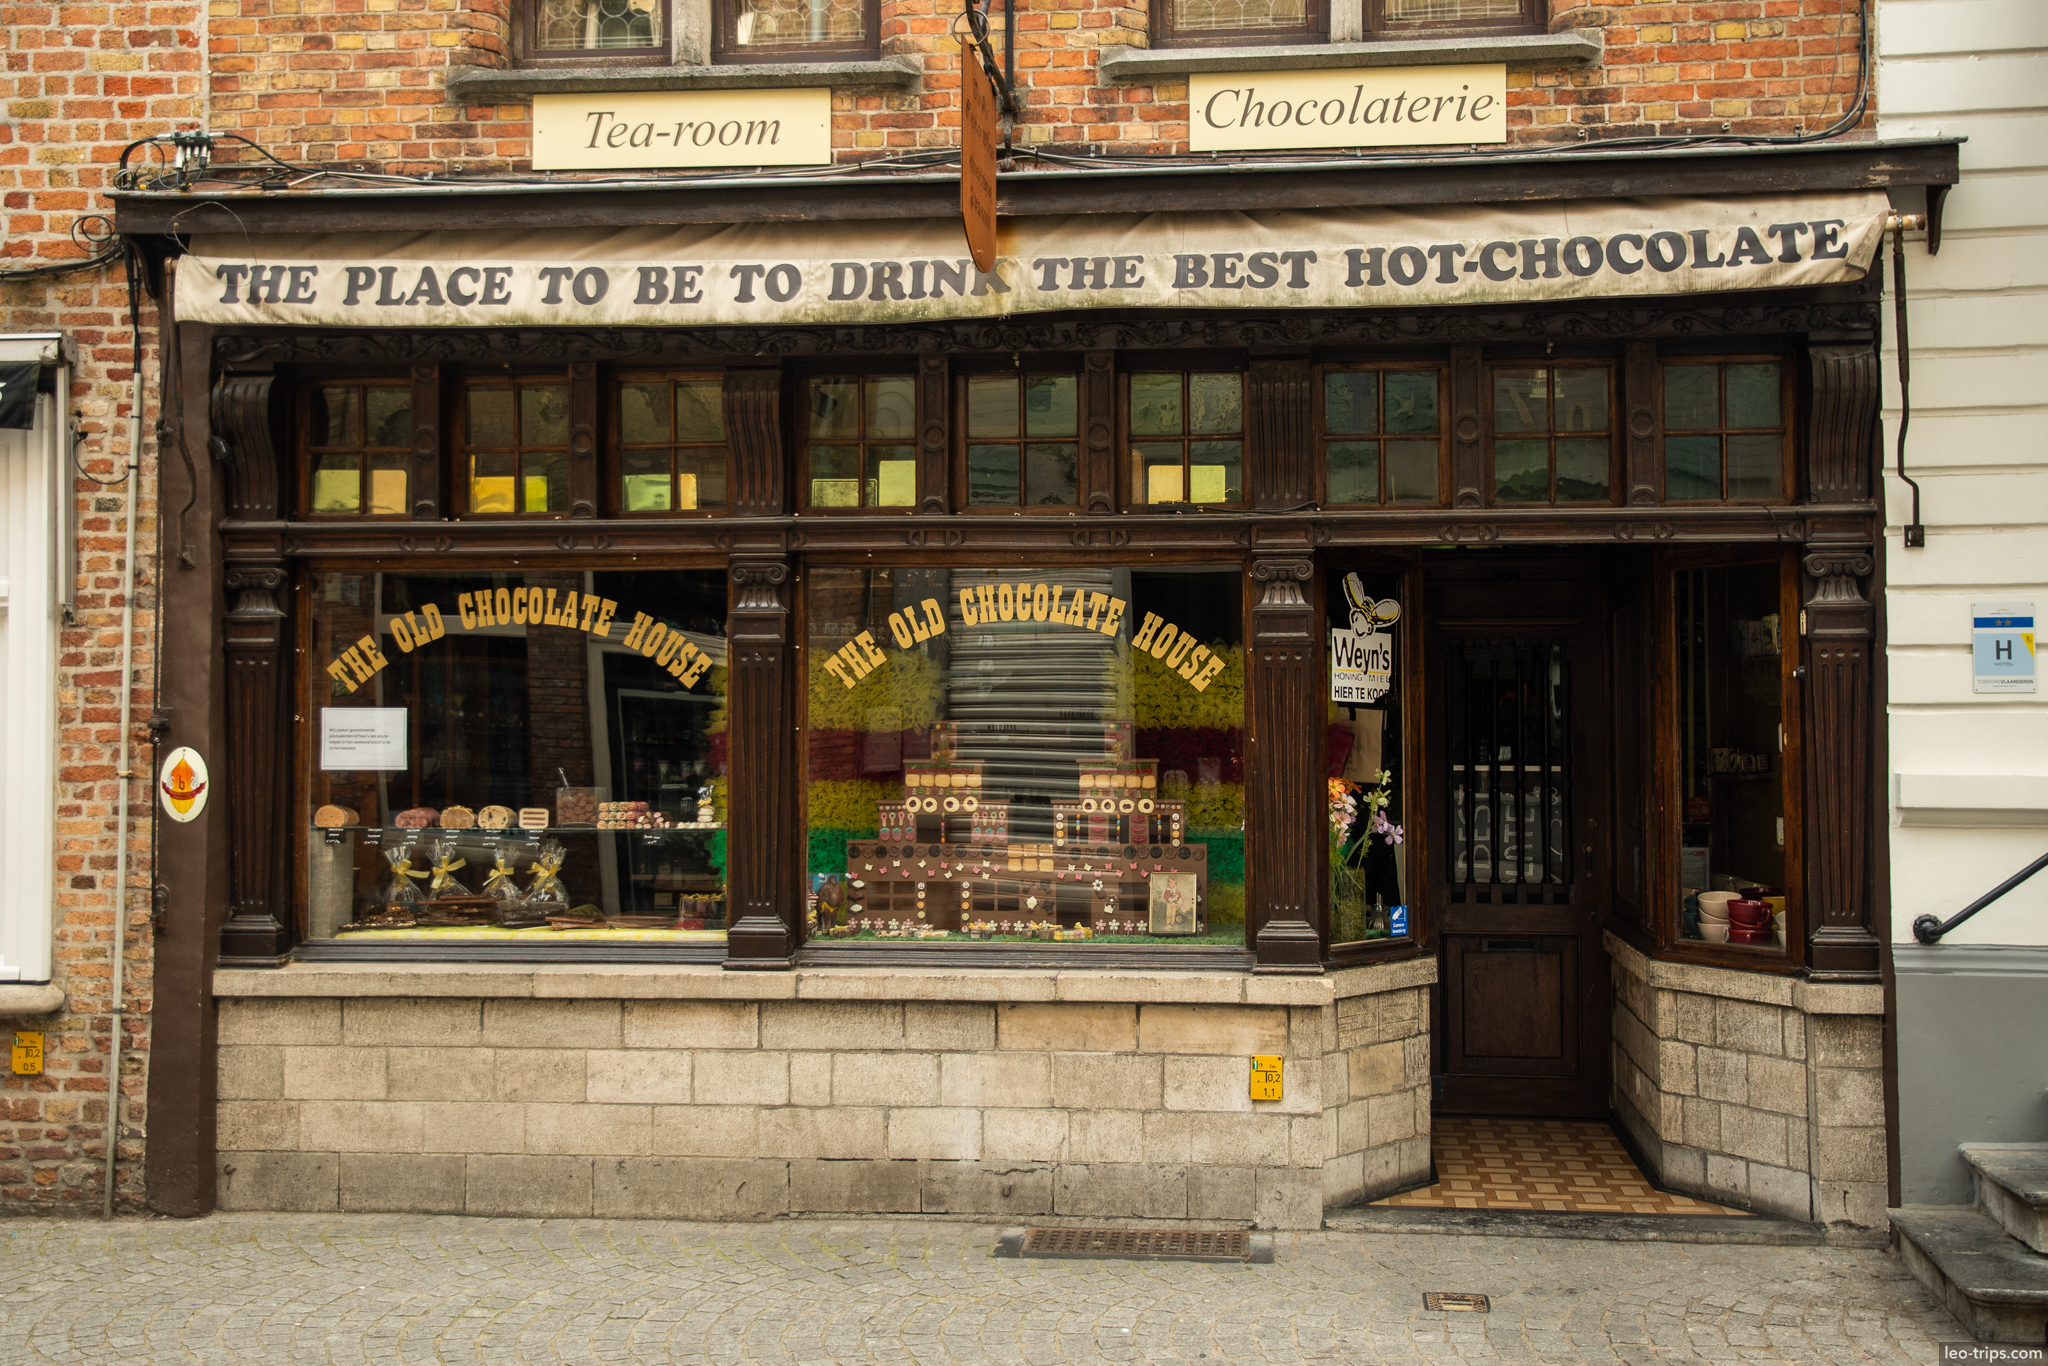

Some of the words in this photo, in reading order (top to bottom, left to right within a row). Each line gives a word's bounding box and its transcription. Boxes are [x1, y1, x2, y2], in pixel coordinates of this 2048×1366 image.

[1204, 83, 1494, 131] Chocolaterie
[585, 111, 780, 149] Tea-room
[215, 263, 319, 306] THE
[343, 265, 513, 307] PLACE
[538, 266, 609, 306] TO
[633, 265, 704, 305] BE
[729, 263, 803, 303] TO
[827, 257, 1012, 302] DRINK
[1033, 254, 1146, 292] THE
[1171, 249, 1318, 289] BEST
[1345, 218, 1850, 288] HOT-CHOCOLATE
[326, 634, 389, 693] THE
[390, 603, 446, 653] OLD
[458, 586, 619, 637] CHOCOLATE
[622, 611, 713, 690] HOUSE
[822, 629, 888, 690] THE
[888, 598, 946, 649] OLD
[959, 582, 1127, 637] CHOCOLATE
[1131, 611, 1226, 692] HOUSE
[1995, 640, 2012, 660] H
[1333, 635, 1390, 675] Weyn's
[1334, 672, 1363, 681] HONING
[1368, 674, 1390, 683] MIEL
[1334, 685, 1354, 699] HIER
[1355, 687, 1365, 700] TE
[1503, 805, 1535, 883] LATE
[23, 1063, 36, 1072] 0,5
[28, 1049, 40, 1058] 0,2
[1267, 1073, 1281, 1083] 0,2
[1264, 1088, 1275, 1098] 1,1
